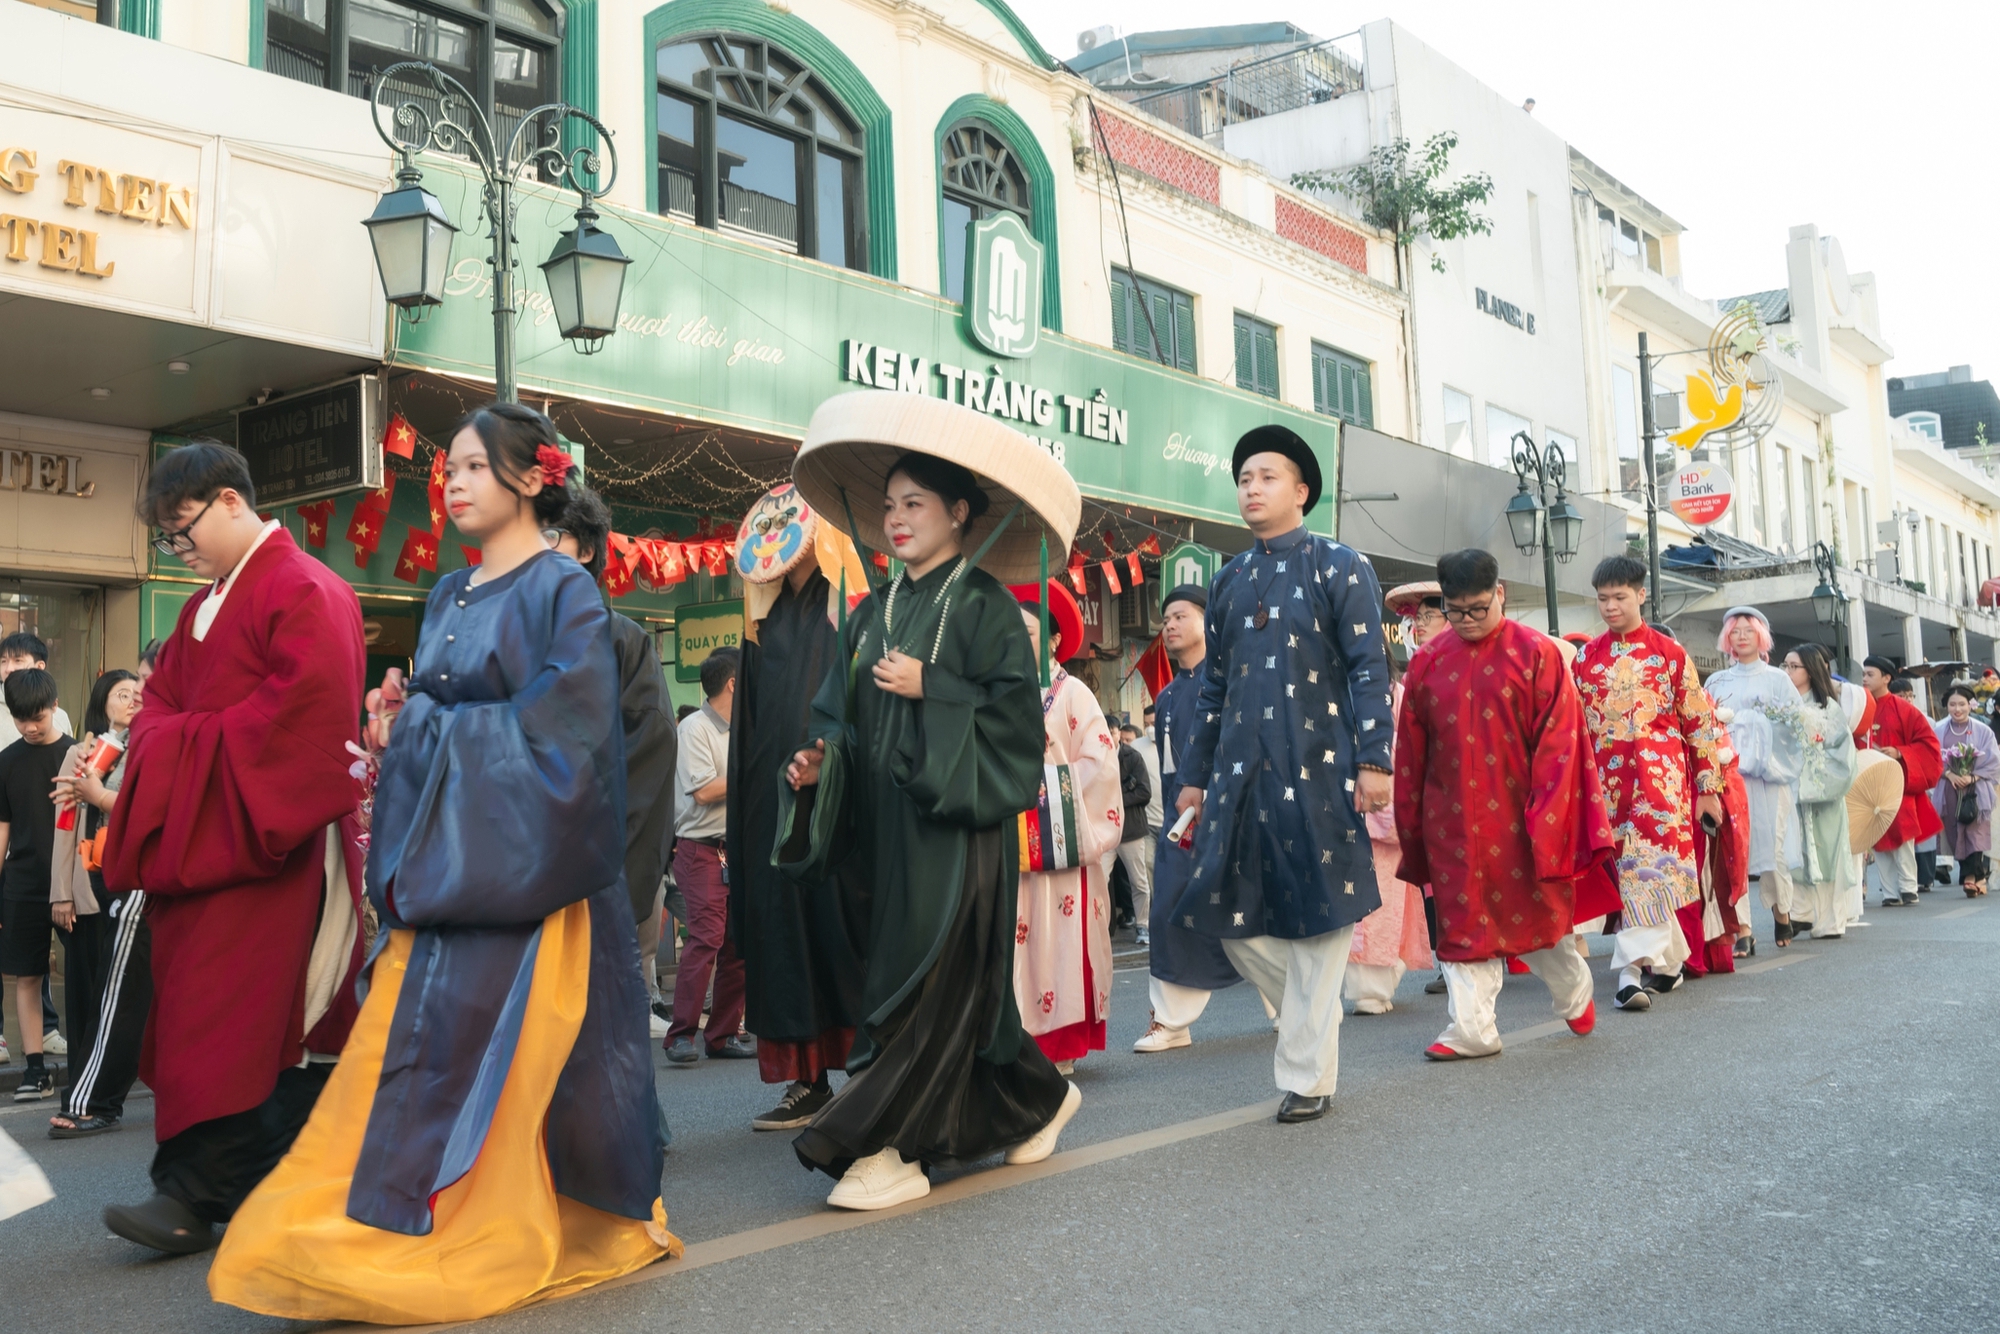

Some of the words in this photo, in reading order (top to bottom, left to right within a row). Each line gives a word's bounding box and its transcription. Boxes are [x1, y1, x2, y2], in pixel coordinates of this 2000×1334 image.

[58, 159, 197, 230] TIEN
[0, 213, 116, 279] TEL
[726, 337, 786, 367] gian
[844, 338, 930, 397] KEM
[934, 363, 1055, 428] TRÀNG
[1059, 387, 1129, 446] TIỀN
[250, 409, 308, 446] TRANG
[311, 398, 348, 430] TIEN
[268, 437, 328, 476] HOTEL
[1680, 472, 1700, 485] HD
[1681, 482, 1714, 497] Bank
[723, 633, 738, 646] 05
